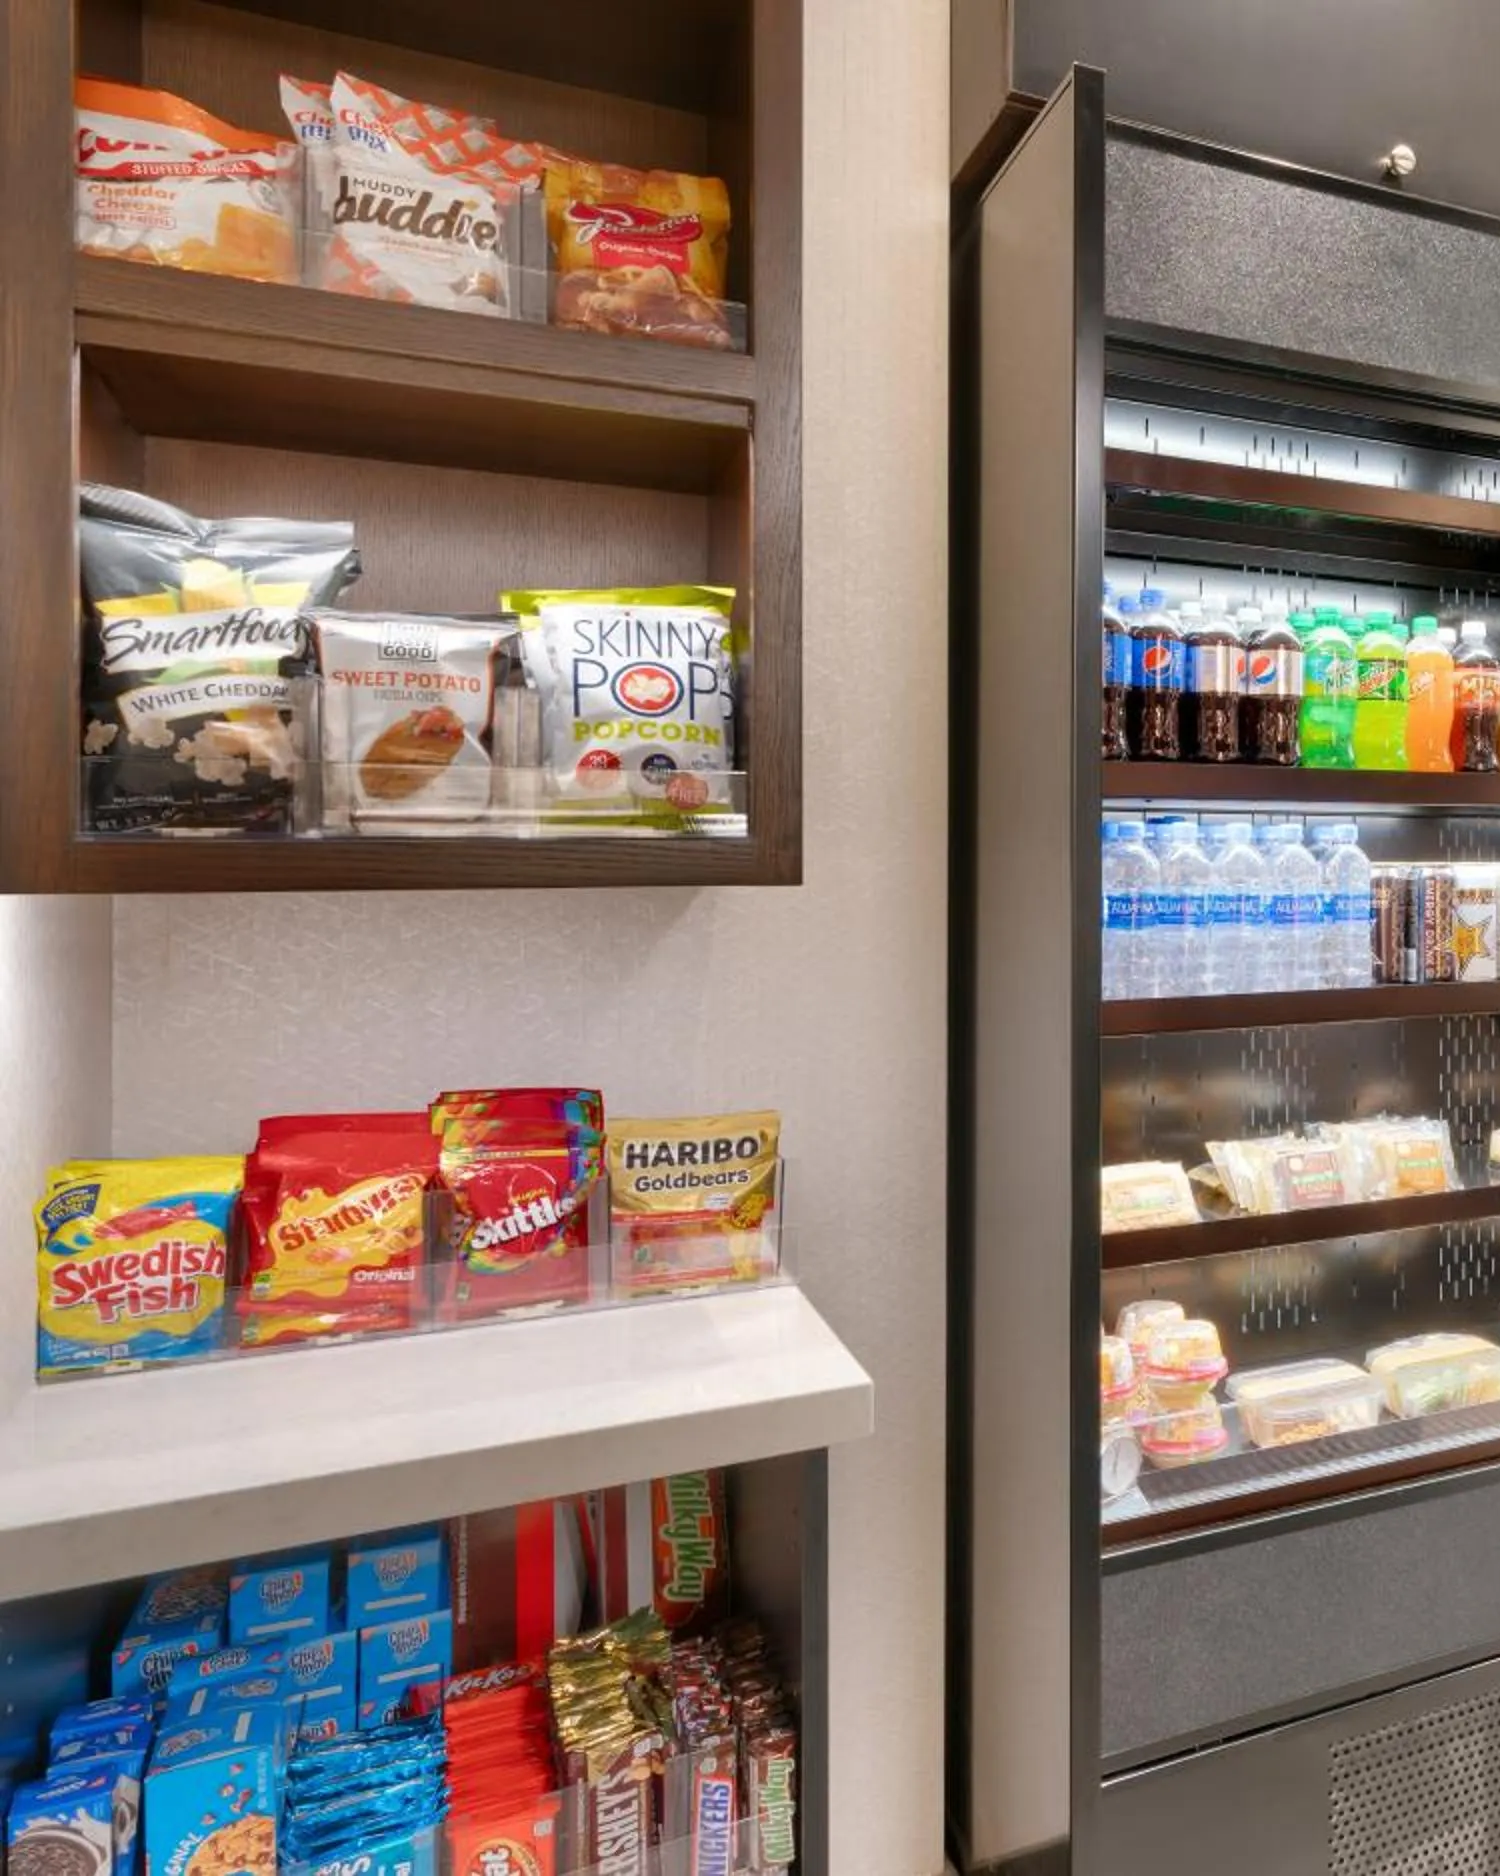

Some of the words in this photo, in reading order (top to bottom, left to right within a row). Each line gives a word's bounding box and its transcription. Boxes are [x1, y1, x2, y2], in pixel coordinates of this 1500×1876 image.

[301, 124, 334, 141] mi
[87, 183, 177, 200] Cheddar
[352, 176, 417, 199] MUDDY
[103, 608, 304, 666] Smartfood
[572, 612, 716, 659] SKINNY
[383, 645, 432, 659] GOOD
[332, 671, 399, 688] SWEET
[404, 672, 481, 693] POTATO
[572, 658, 718, 720] POP
[130, 687, 201, 715] WHITE
[572, 721, 722, 746] POPCORN
[625, 1135, 759, 1169] HARIBO
[634, 1168, 749, 1193] Goldbears
[52, 1240, 226, 1306] Swedish
[353, 1263, 416, 1282] Original
[93, 1277, 198, 1324] Fish
[597, 1768, 640, 1876] ERSHEY'S
[700, 1781, 731, 1876] NICKERS
